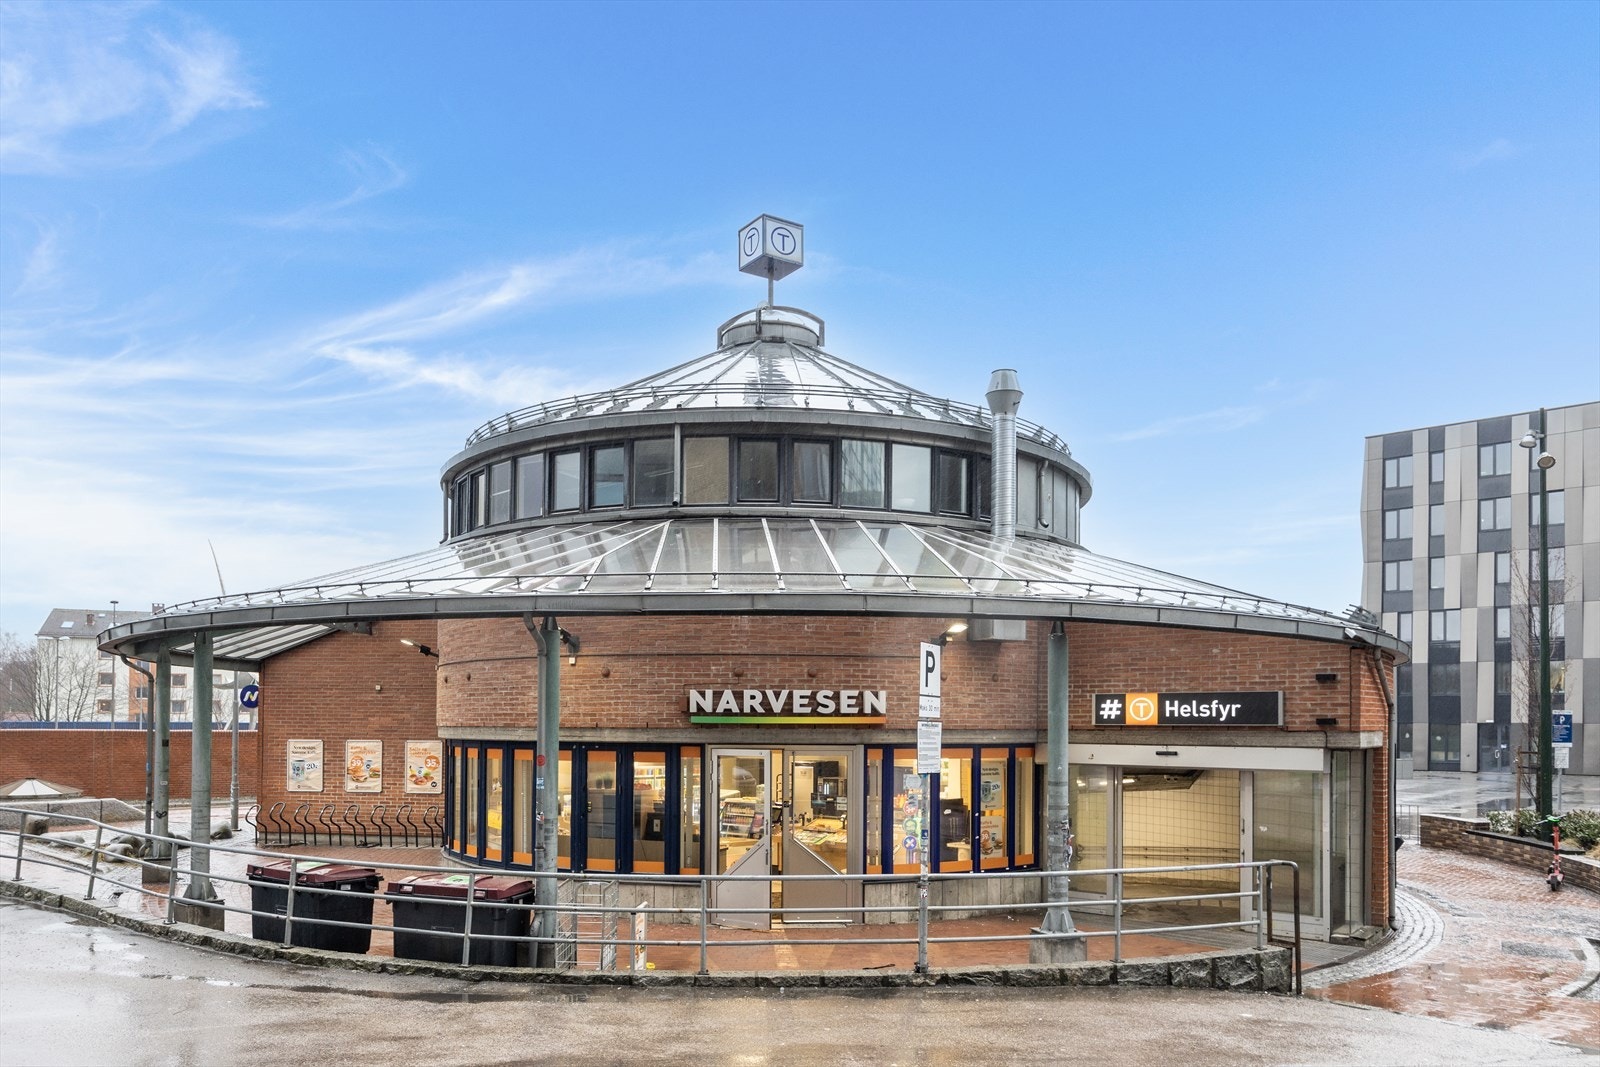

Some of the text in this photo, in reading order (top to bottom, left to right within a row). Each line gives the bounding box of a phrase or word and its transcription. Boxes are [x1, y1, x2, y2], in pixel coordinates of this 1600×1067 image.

[747, 233, 756, 252] T
[777, 232, 789, 251] T
[925, 650, 936, 687] P
[689, 689, 887, 714] NARVESEN
[1135, 702, 1148, 718] T
[1165, 700, 1241, 722] Helsfyr
[1560, 716, 1566, 724] P
